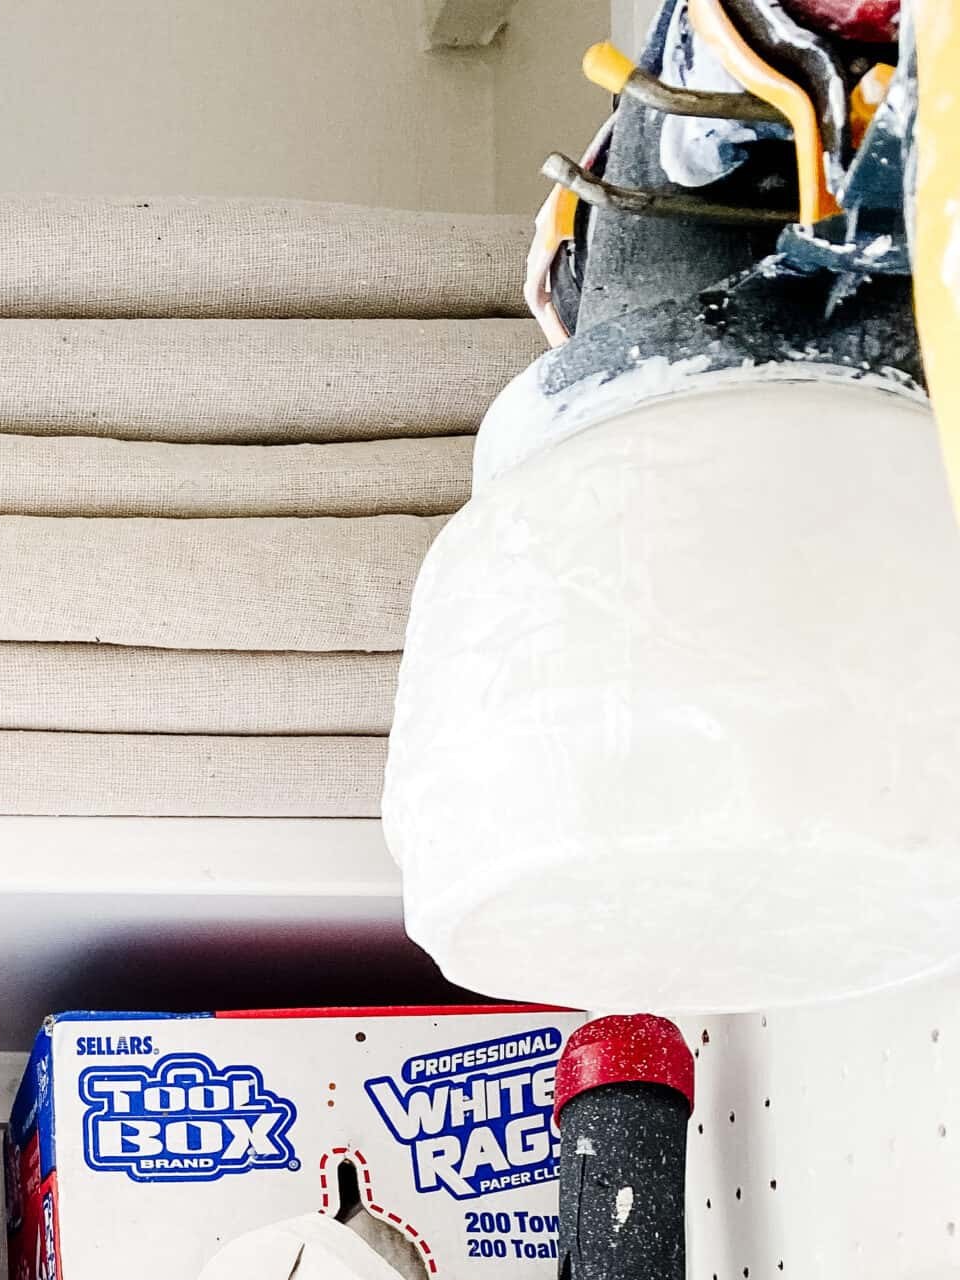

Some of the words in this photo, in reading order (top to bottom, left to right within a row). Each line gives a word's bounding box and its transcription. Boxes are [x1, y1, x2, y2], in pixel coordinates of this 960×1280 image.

[76, 1036, 153, 1056] SELLARS
[410, 1032, 557, 1080] PROFESSIONAL
[93, 1079, 267, 1112] TOOL
[98, 1112, 284, 1160] BOX
[140, 1158, 214, 1169] BRAND
[415, 1113, 560, 1195] RAG
[480, 1169, 531, 1192] PAPER
[464, 1212, 512, 1234] 200
[467, 1239, 507, 1258] 200
